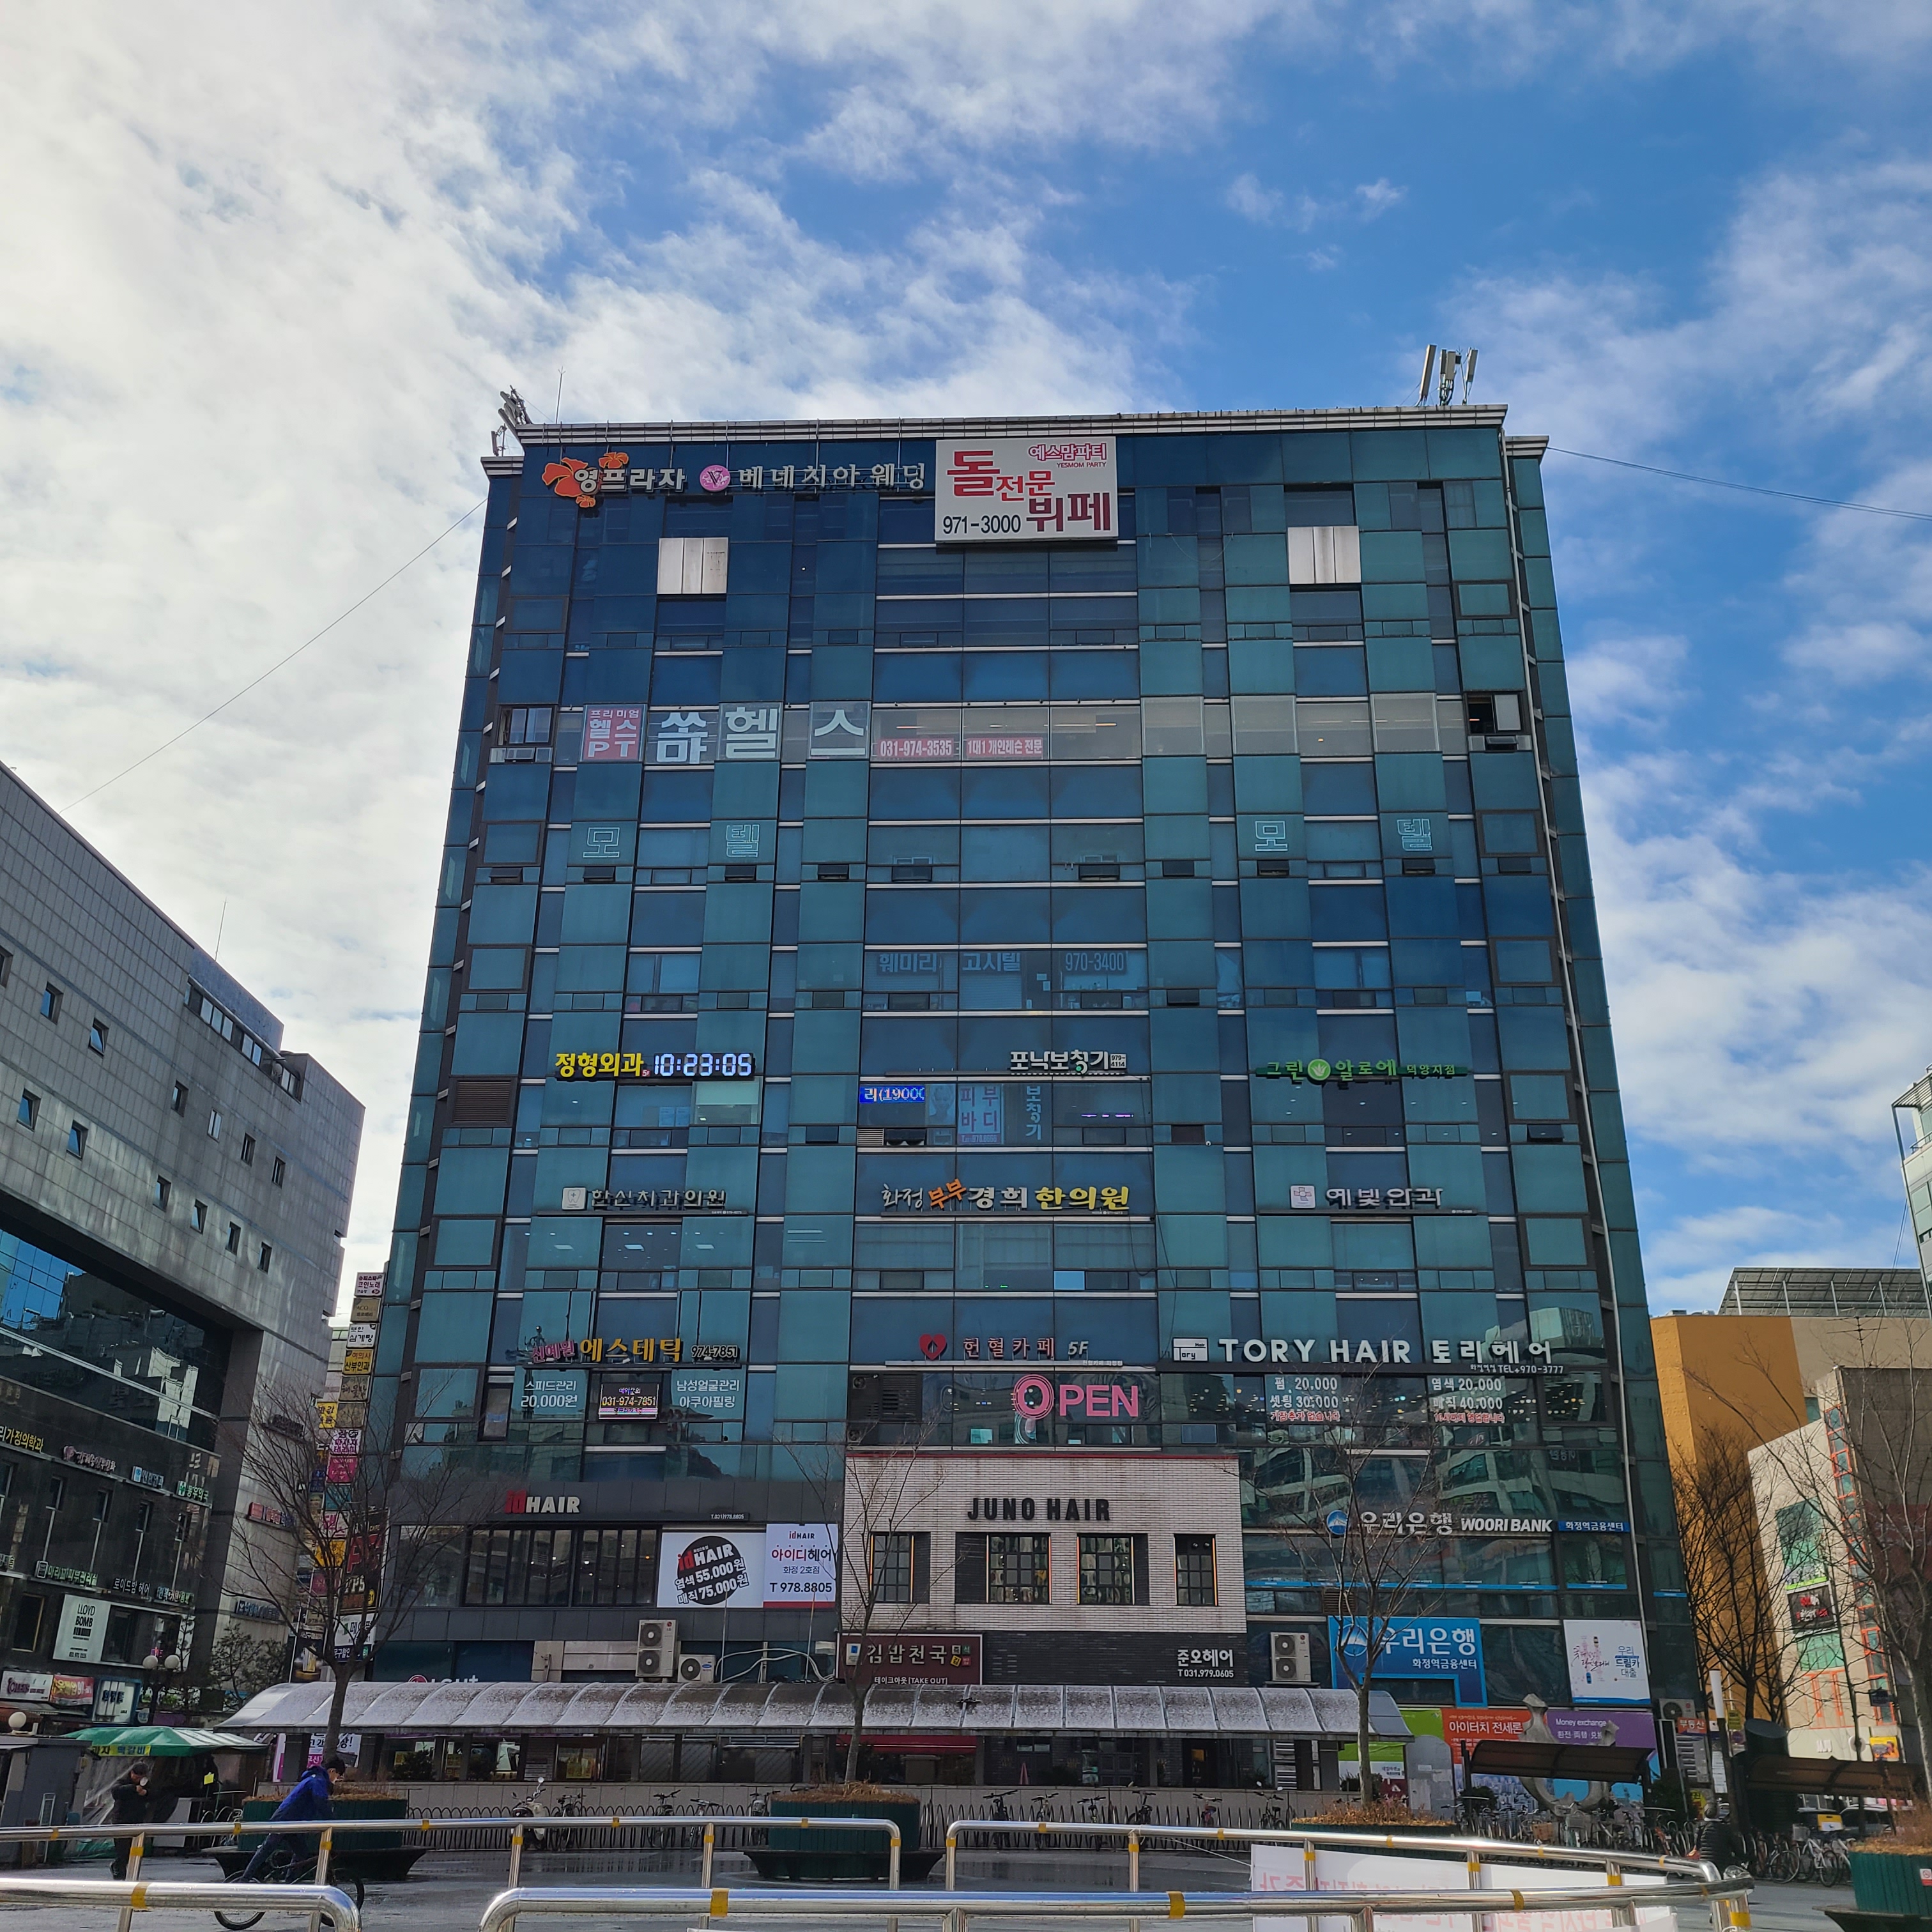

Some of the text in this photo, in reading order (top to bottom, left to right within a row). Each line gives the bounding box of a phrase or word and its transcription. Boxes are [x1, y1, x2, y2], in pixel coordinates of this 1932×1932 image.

[1029, 443, 1107, 461] 예스맘파티
[574, 467, 686, 493] 영프라자
[739, 463, 925, 491] 베네치아 웨딩
[947, 450, 1055, 501] 돌 전문
[1026, 493, 1111, 532] 뷔페
[943, 515, 1021, 534] 971-3000
[590, 710, 639, 718] 프리미엄
[589, 719, 636, 739] 헬스
[588, 741, 635, 757] PT
[880, 739, 952, 757] 031-974-3535
[967, 739, 1043, 756] 1대1 개인레슨 전문
[879, 953, 937, 972] 훼미리
[1065, 953, 1124, 971] 970-3400
[555, 1052, 644, 1077] 정형외과
[654, 1053, 751, 1077] 10:23:05
[1010, 1049, 1108, 1074] 포낙보청기
[1267, 1059, 1304, 1082] 그린
[1335, 1059, 1397, 1082] 알로에
[960, 1087, 999, 1107] 피부
[961, 1110, 997, 1132] 바디
[1025, 1085, 1042, 1140] 보청기
[592, 1189, 726, 1207] 한신치과의원
[881, 1179, 1130, 1211] 화정 부부 경희 한의원
[1326, 1188, 1443, 1207] 예빛안과
[531, 1338, 739, 1364] 신혜원 에스테틱 974-7851
[963, 1337, 1089, 1359] 헌혈카페 5F
[1218, 1339, 1552, 1364] TORY HAIR 토리헤어
[345, 1362, 370, 1371] 산부인과
[1470, 1364, 1496, 1373] 화정역점
[525, 1381, 577, 1392] 스피드관리
[677, 1379, 740, 1392] 남성얼굴관리
[1275, 1377, 1338, 1390] 펌 20,000
[1431, 1378, 1501, 1392] 염색 20,000
[521, 1395, 578, 1408] 20,000원
[602, 1396, 656, 1406] 031-974-7851
[678, 1397, 735, 1408] 아쿠아필링
[1013, 1374, 1138, 1420] OPEN
[1269, 1395, 1338, 1408] 셋팅 30,000
[1433, 1396, 1503, 1410] 매직 40,000
[1307, 1411, 1340, 1422] 없습니다
[967, 1498, 1110, 1521] JUNO HAIR
[1358, 1511, 1623, 1535] 우리은행 WOORI BANK 화정역금융센터
[771, 1548, 832, 1561] 아이디헤어
[675, 1557, 746, 1590] 염색 55,000원
[800, 1566, 820, 1574] 2호점
[139, 1582, 150, 1597] 헤어
[677, 1573, 749, 1605] 매직 75,000원
[770, 1583, 832, 1593] T 978.8805
[77, 1604, 96, 1616] LLOYD
[75, 1616, 93, 1627] BOMB
[1381, 1628, 1476, 1656] 우리은행
[1618, 1646, 1634, 1655] 우리
[867, 1644, 947, 1665] 김밥천국
[1177, 1649, 1234, 1667] 준오헤어
[1412, 1658, 1477, 1669] 화정역금융센터
[1616, 1659, 1640, 1668] 드림카
[1621, 1668, 1637, 1678] 대출
[1449, 1721, 1524, 1735] 아이터치 전세론
[1680, 1720, 1705, 1729] 부동산
